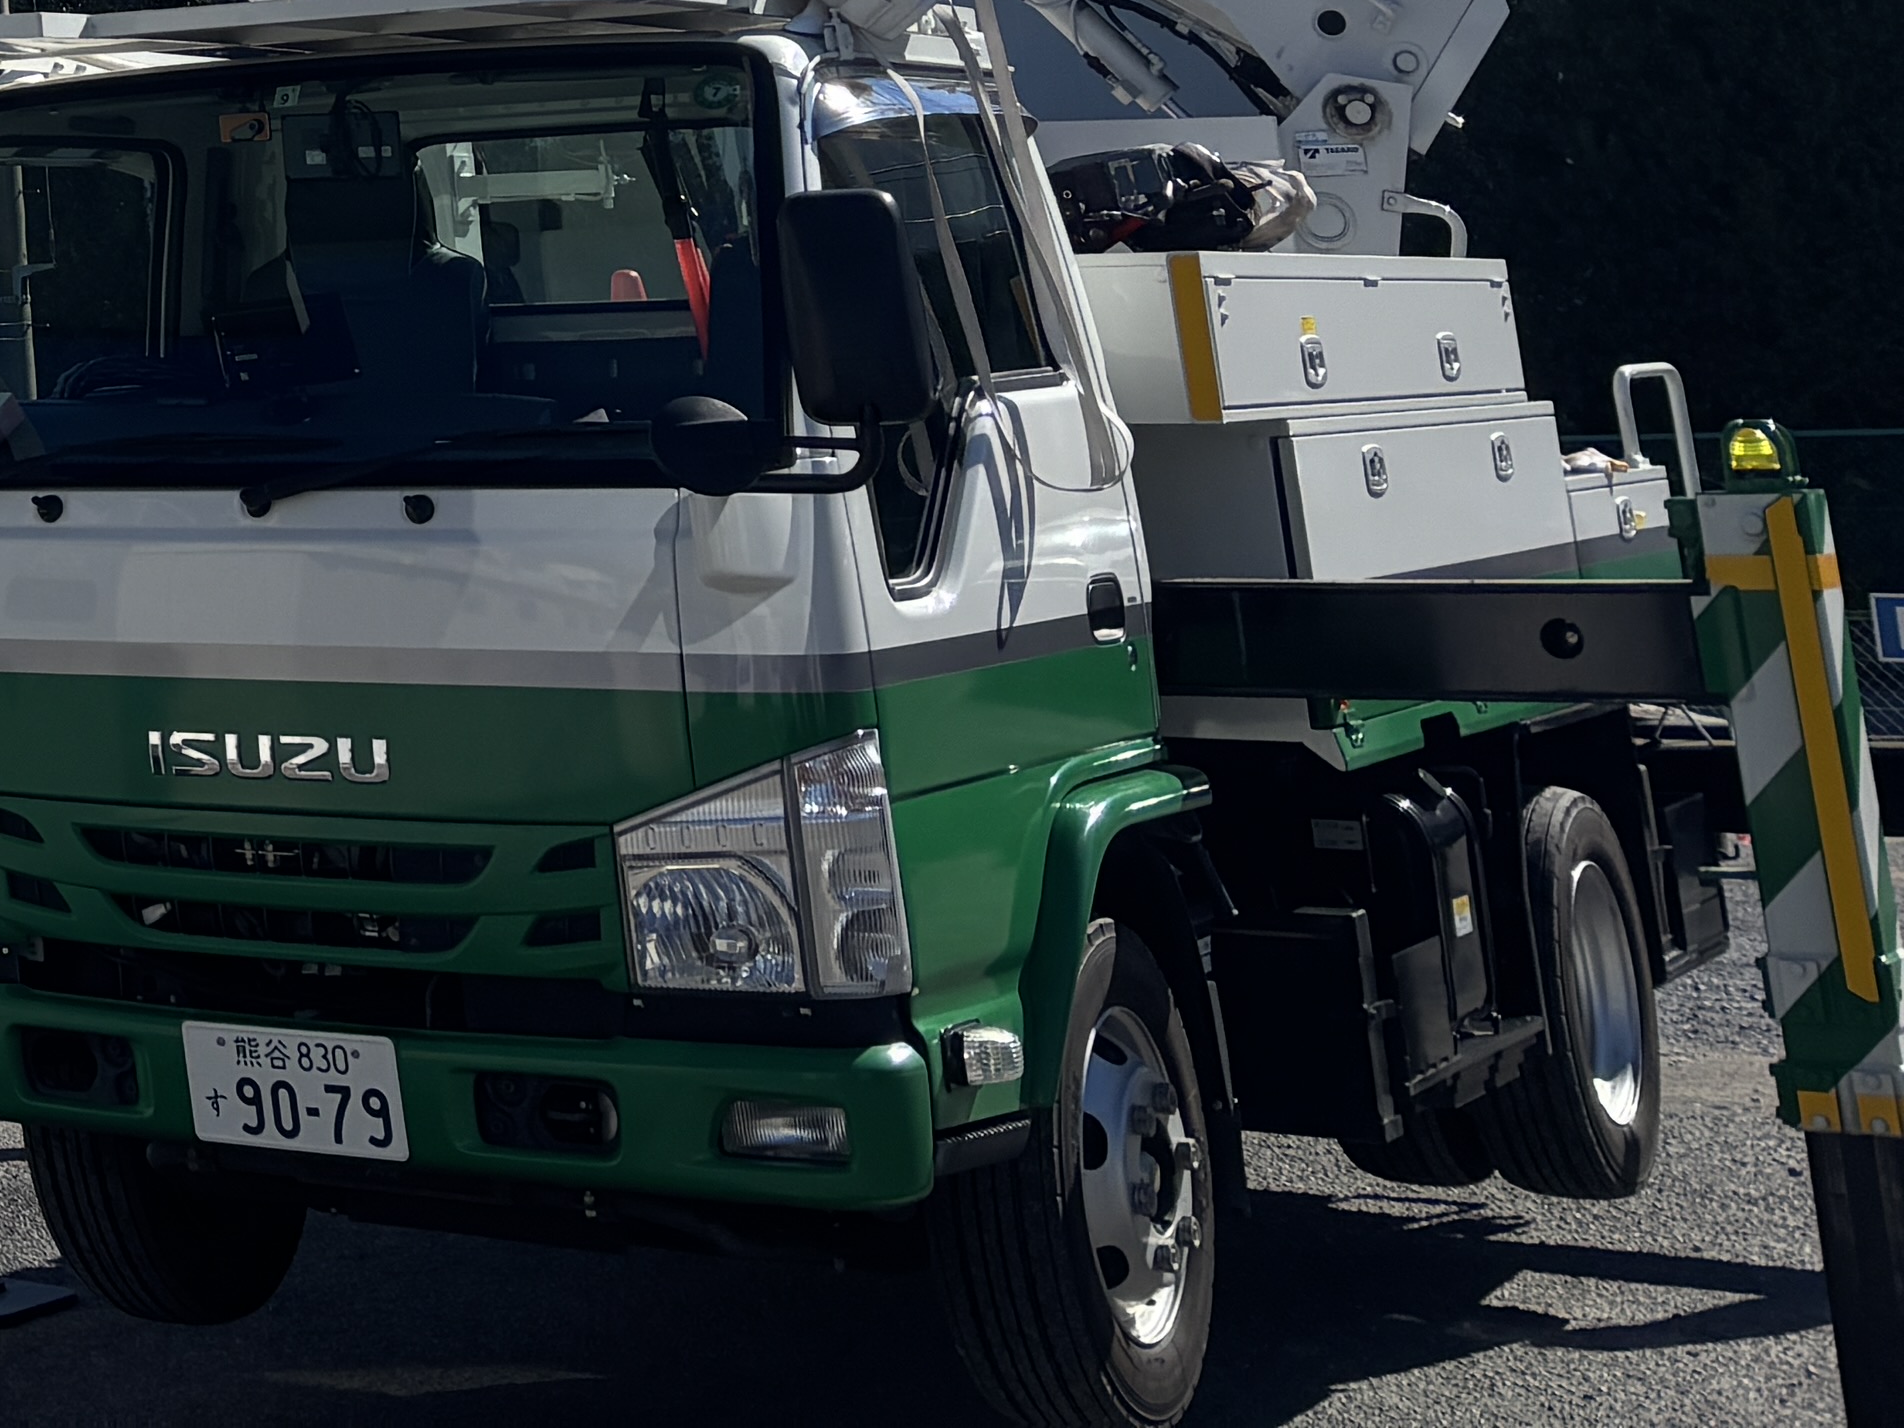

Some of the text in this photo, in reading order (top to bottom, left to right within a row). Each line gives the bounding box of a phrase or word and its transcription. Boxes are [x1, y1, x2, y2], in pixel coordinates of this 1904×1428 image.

[148, 730, 390, 783] ISUZU
[233, 1036, 349, 1076] 熊谷 830
[205, 1076, 394, 1149] す 90-79
